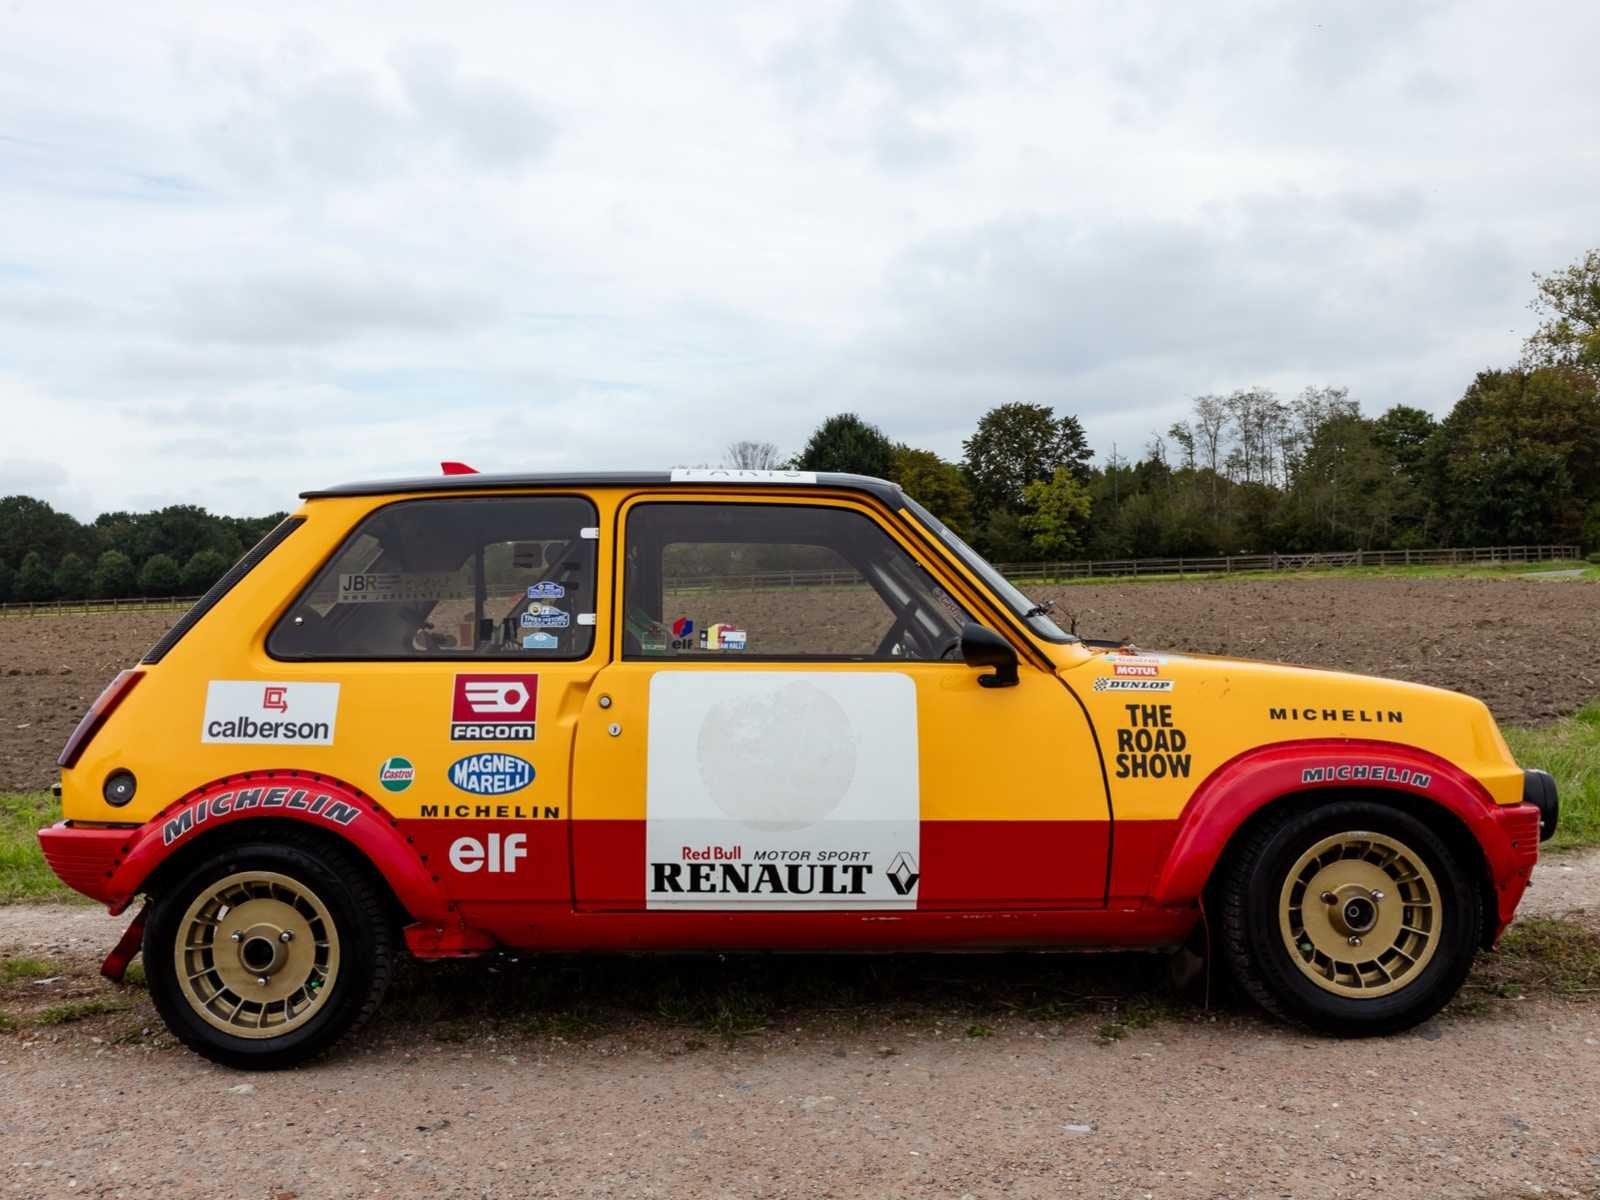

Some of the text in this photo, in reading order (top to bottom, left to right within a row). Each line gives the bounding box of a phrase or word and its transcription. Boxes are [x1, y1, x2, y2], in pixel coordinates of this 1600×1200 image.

[343, 575, 376, 591] JBR
[672, 640, 693, 649] elf
[1116, 666, 1157, 675] MOTUL
[1109, 681, 1170, 689] DUNLOP
[1125, 704, 1174, 727] THE
[1269, 708, 1403, 723] MICHELIN
[208, 717, 329, 739] calberson
[453, 725, 533, 739] FACOM
[1117, 728, 1187, 753] ROAD
[384, 770, 413, 779] Castrol
[454, 754, 529, 782] MAGNETI
[1115, 753, 1192, 778] SHOW
[1302, 765, 1431, 788] MICHELIN
[454, 765, 529, 793] MARELLI
[163, 787, 361, 846] MICHELIN
[420, 805, 560, 819] MICHELIN
[449, 832, 528, 873] elf
[682, 847, 870, 861] Red Bull MOTOR SPORT
[650, 862, 873, 895] RENAULT
